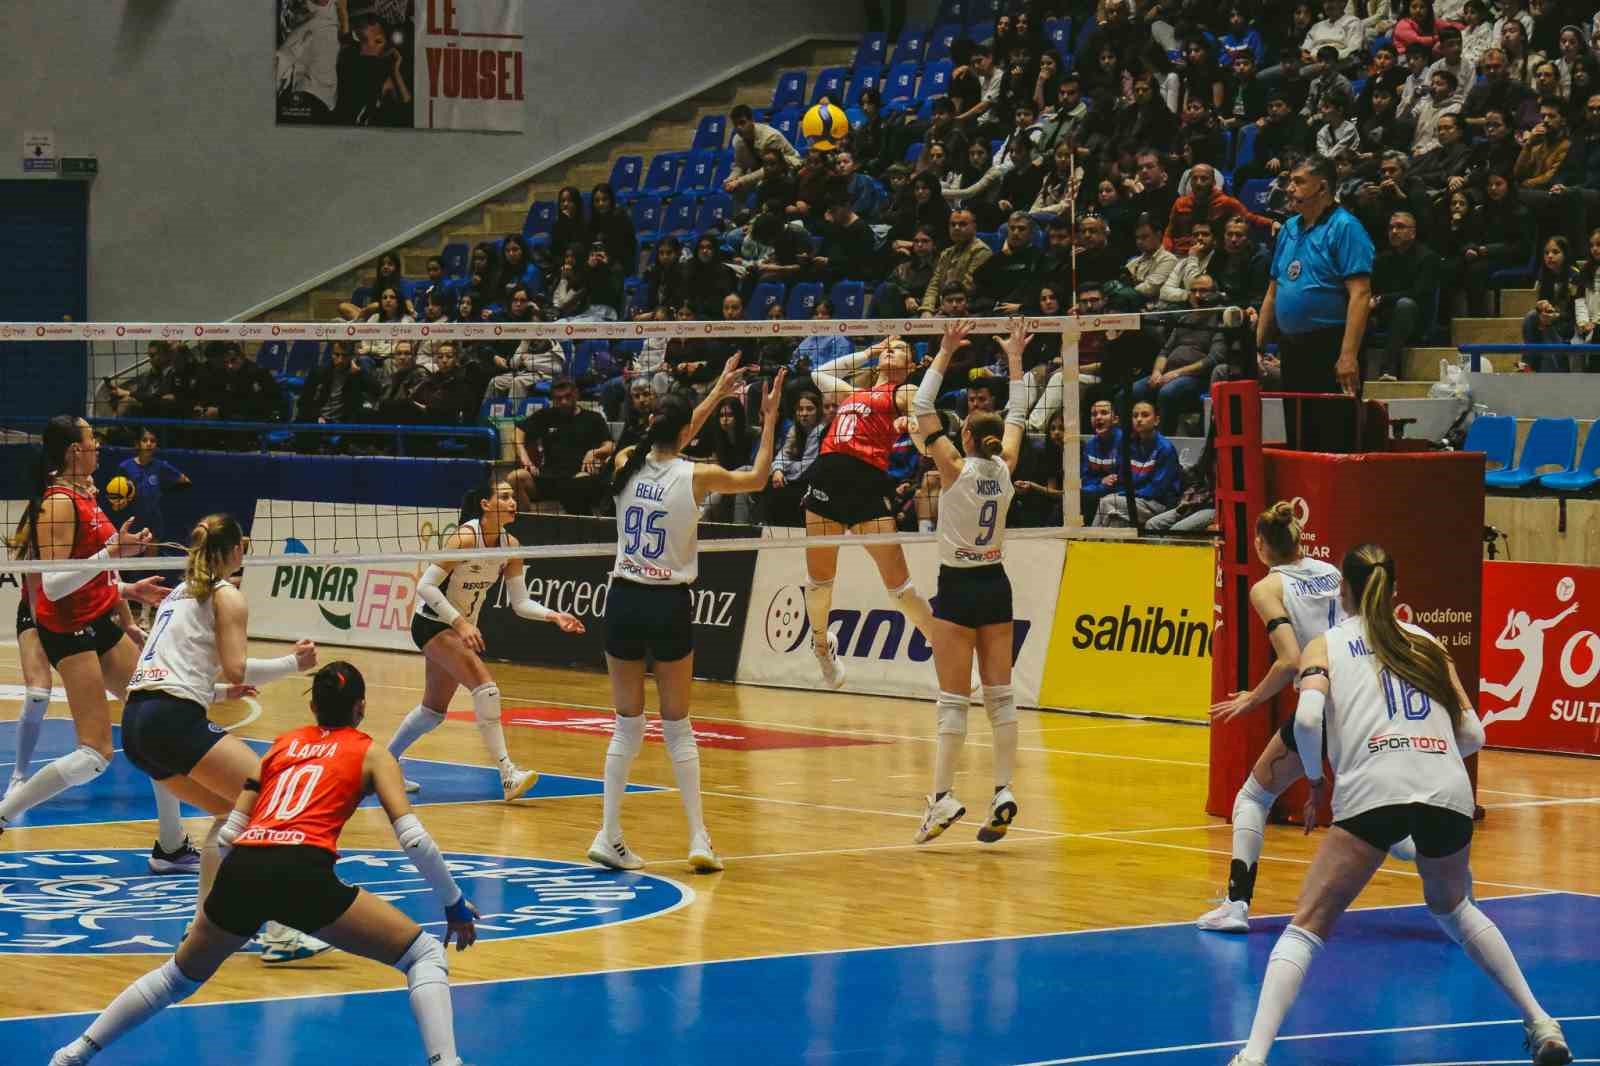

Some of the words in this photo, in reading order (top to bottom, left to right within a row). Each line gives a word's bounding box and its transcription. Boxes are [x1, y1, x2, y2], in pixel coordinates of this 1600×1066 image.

[625, 505, 668, 559] 95
[975, 500, 997, 545] 9
[270, 565, 358, 602] PINAR
[1416, 608, 1473, 624] vodafone
[1550, 698, 1600, 723] SULT
[264, 764, 324, 821] 10
